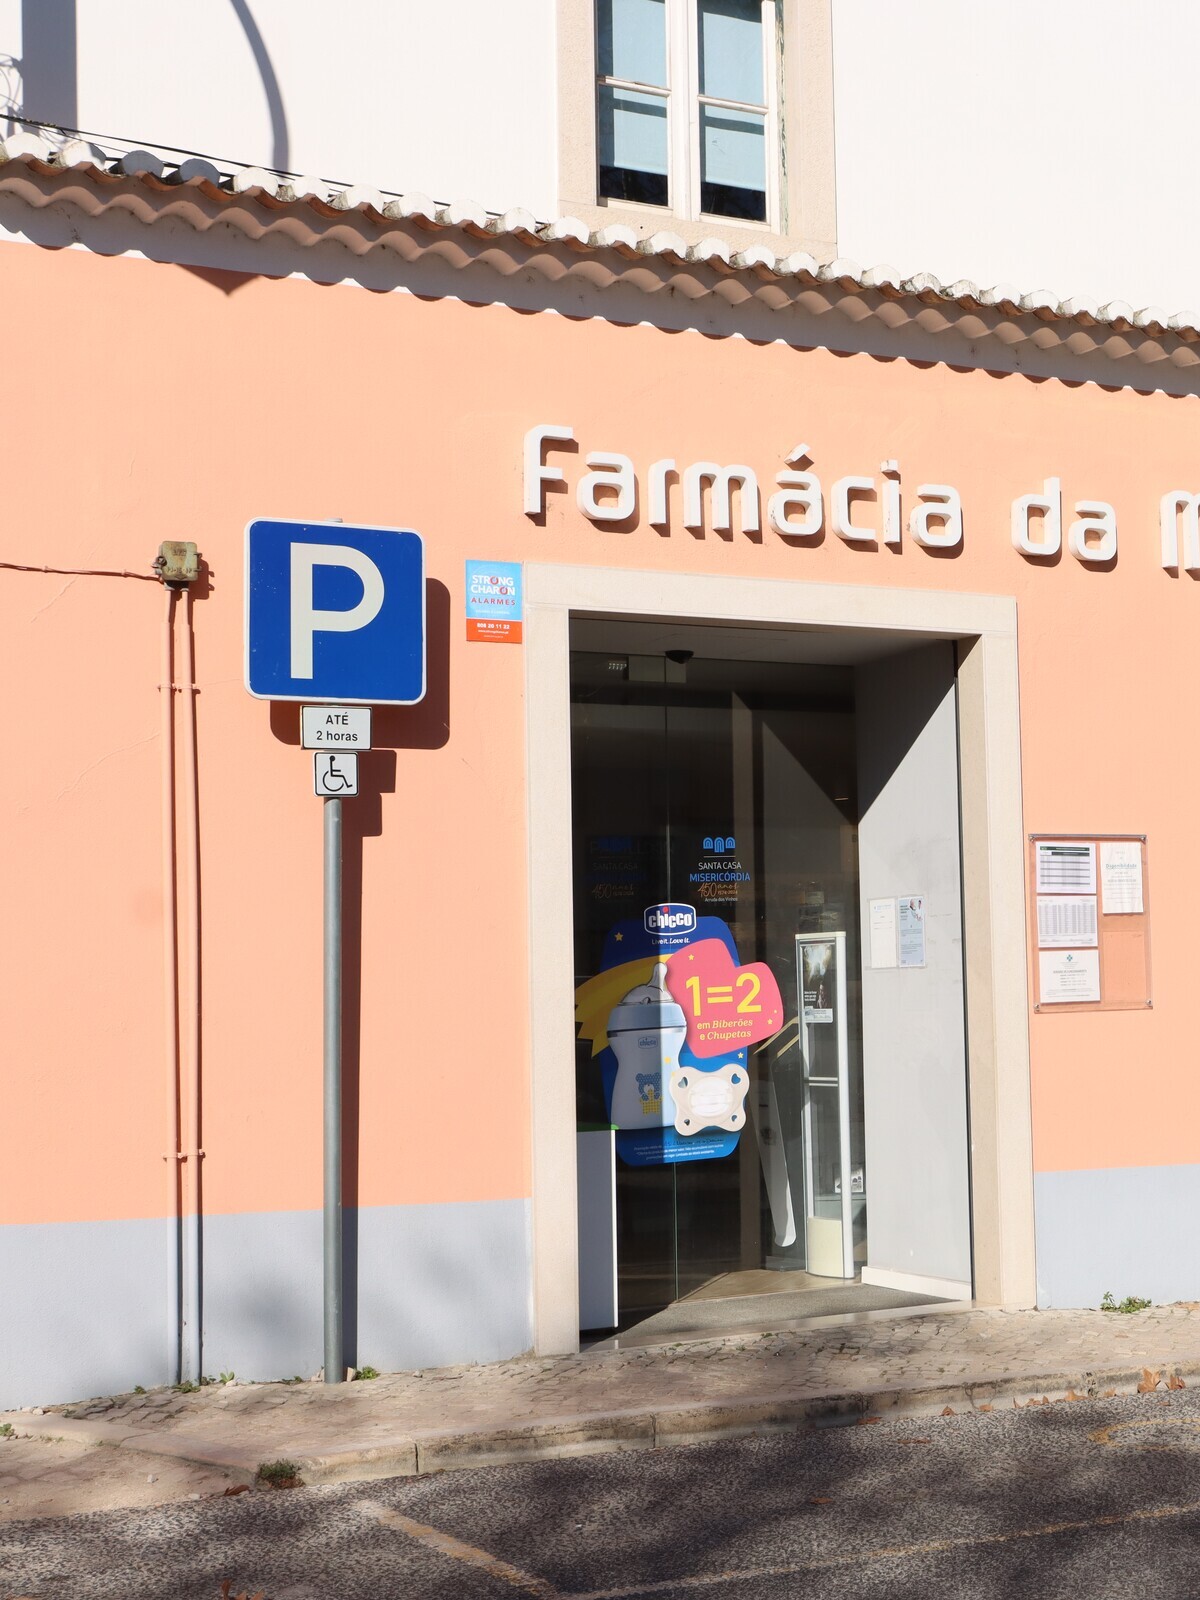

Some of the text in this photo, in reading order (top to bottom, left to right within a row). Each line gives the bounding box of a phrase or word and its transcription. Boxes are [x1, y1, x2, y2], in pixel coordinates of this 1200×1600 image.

[524, 424, 962, 547] Farmácia
[1011, 477, 1116, 561] da
[472, 575, 514, 586] STRONG
[471, 585, 515, 596] CHARON
[471, 597, 515, 605] ALARMES
[291, 542, 384, 679] P
[325, 712, 349, 725] ATÉ
[316, 730, 358, 741] 2 horas
[698, 862, 742, 870] SANTA CASA
[690, 872, 750, 882] MISERICÓRDIA
[648, 906, 692, 929] chicco
[686, 973, 762, 1016] 1=2
[697, 1018, 753, 1030] em Biberões
[700, 1030, 752, 1042] e Chupetas
